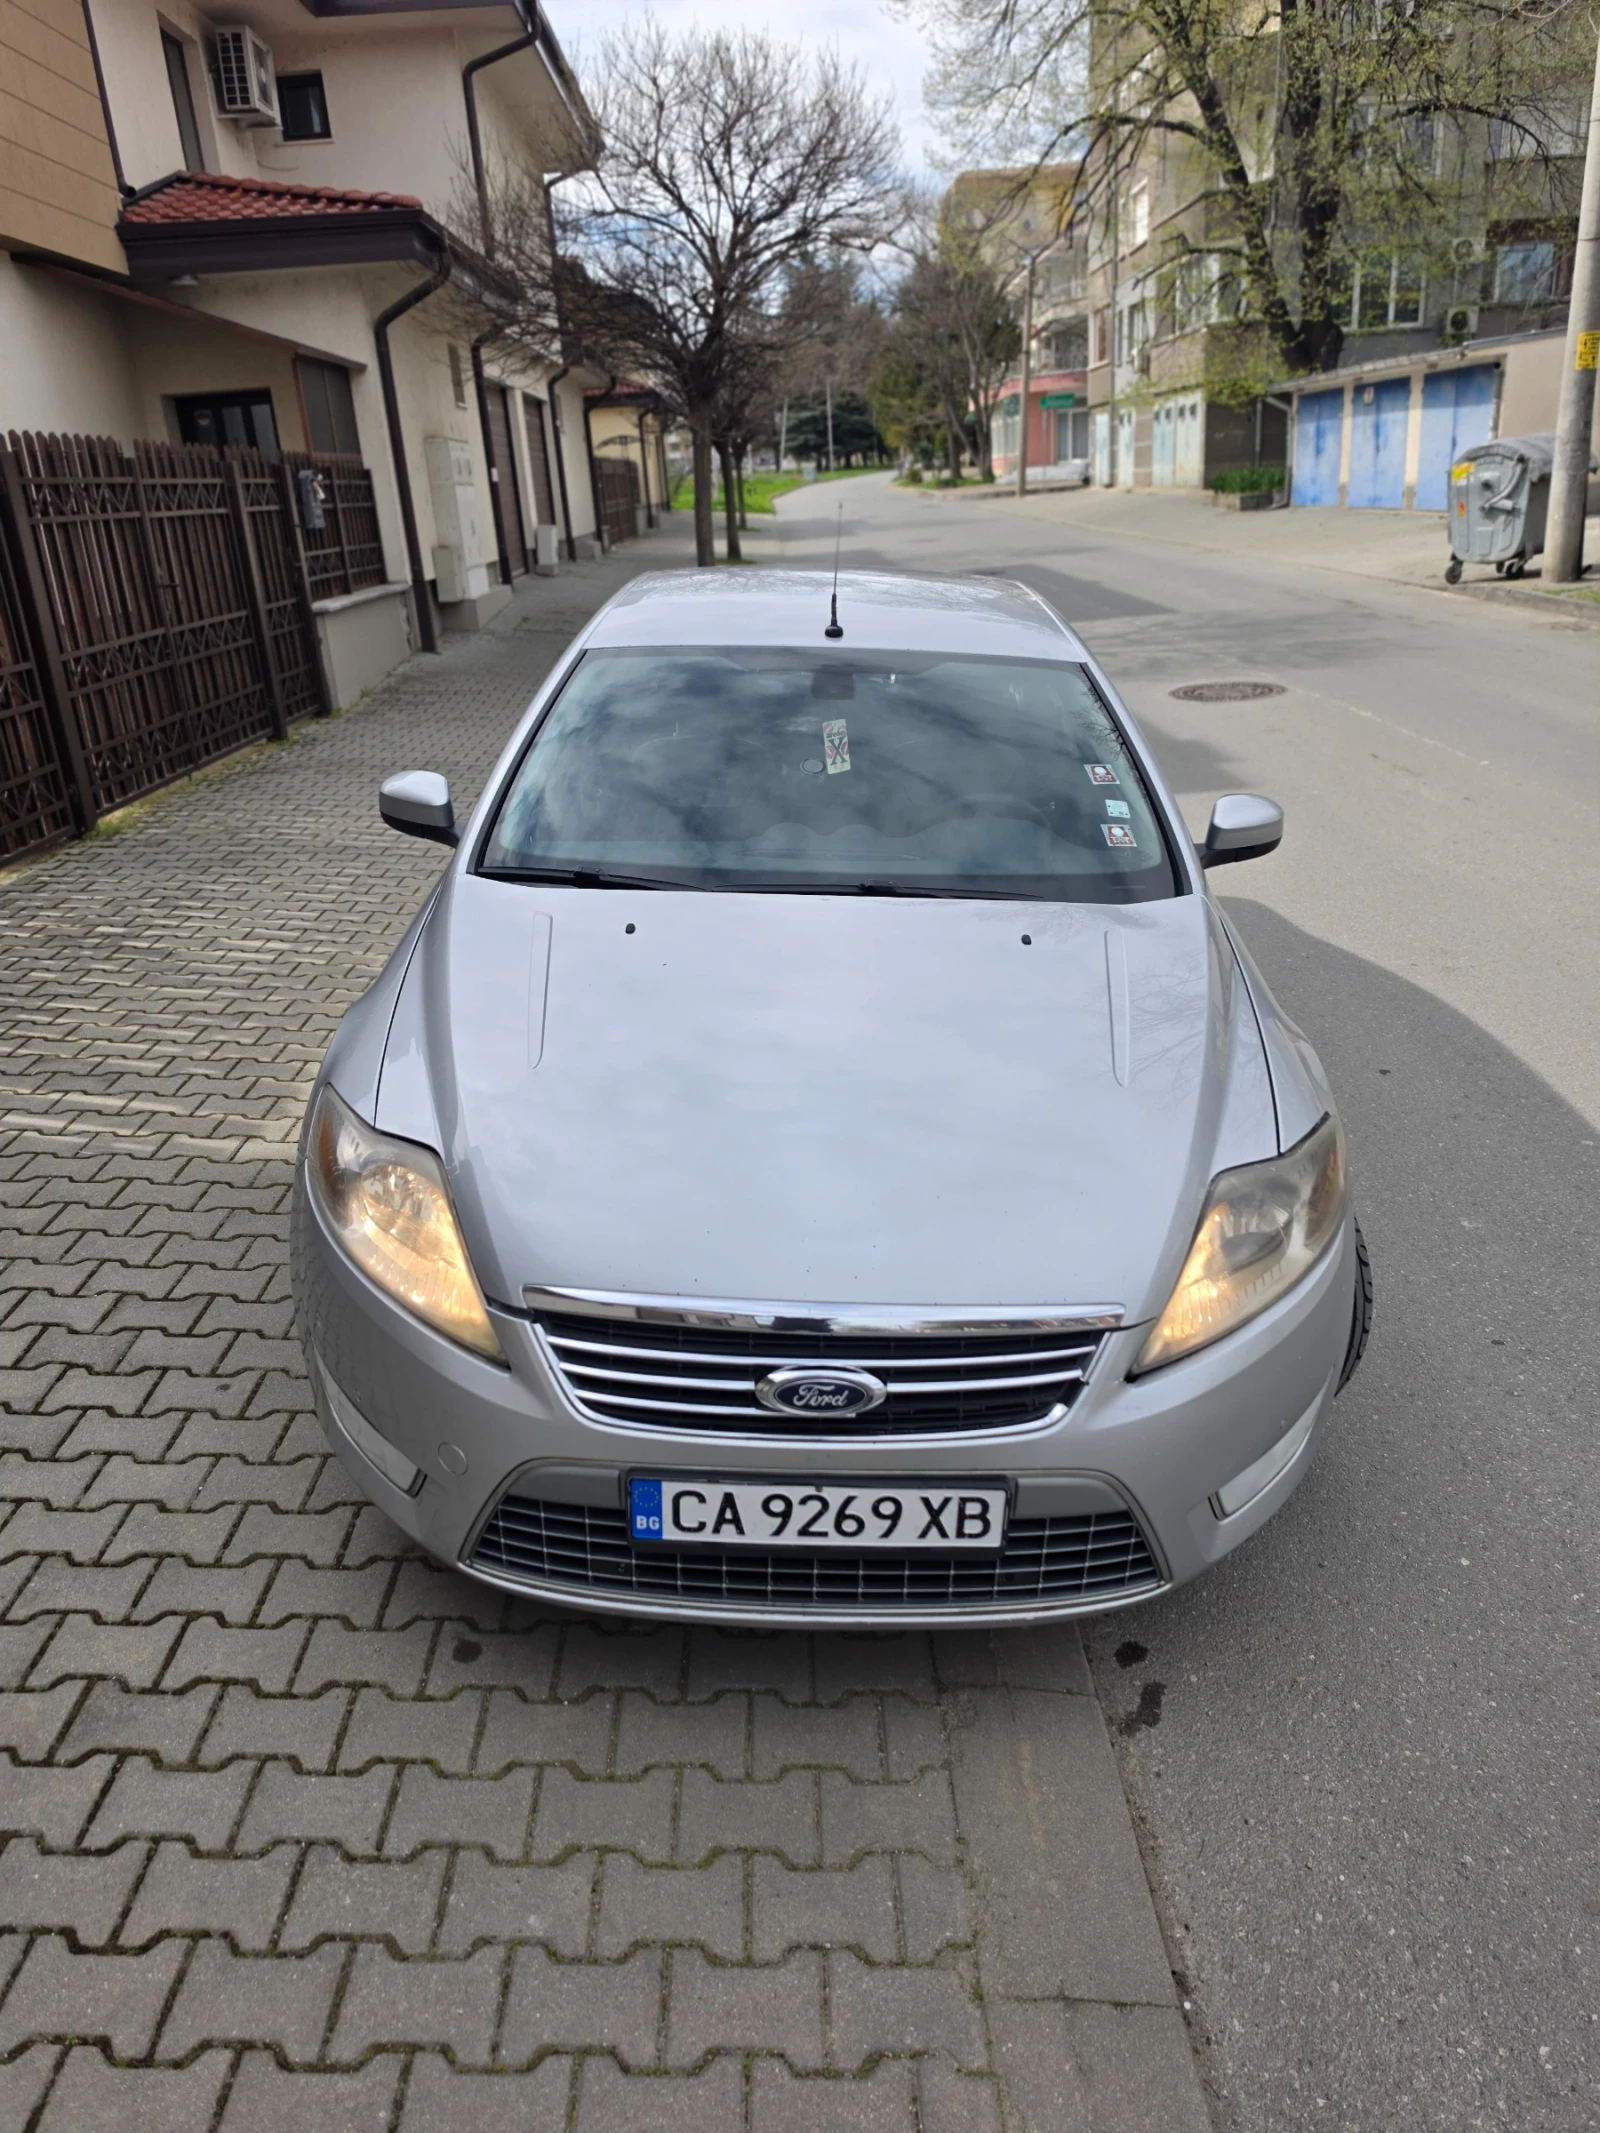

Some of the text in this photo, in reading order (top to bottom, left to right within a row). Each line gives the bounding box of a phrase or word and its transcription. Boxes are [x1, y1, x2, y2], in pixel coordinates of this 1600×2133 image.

[793, 1384, 849, 1407] Ford
[636, 1515, 660, 1530] BG
[671, 1489, 992, 1540] CA 9269 XB
